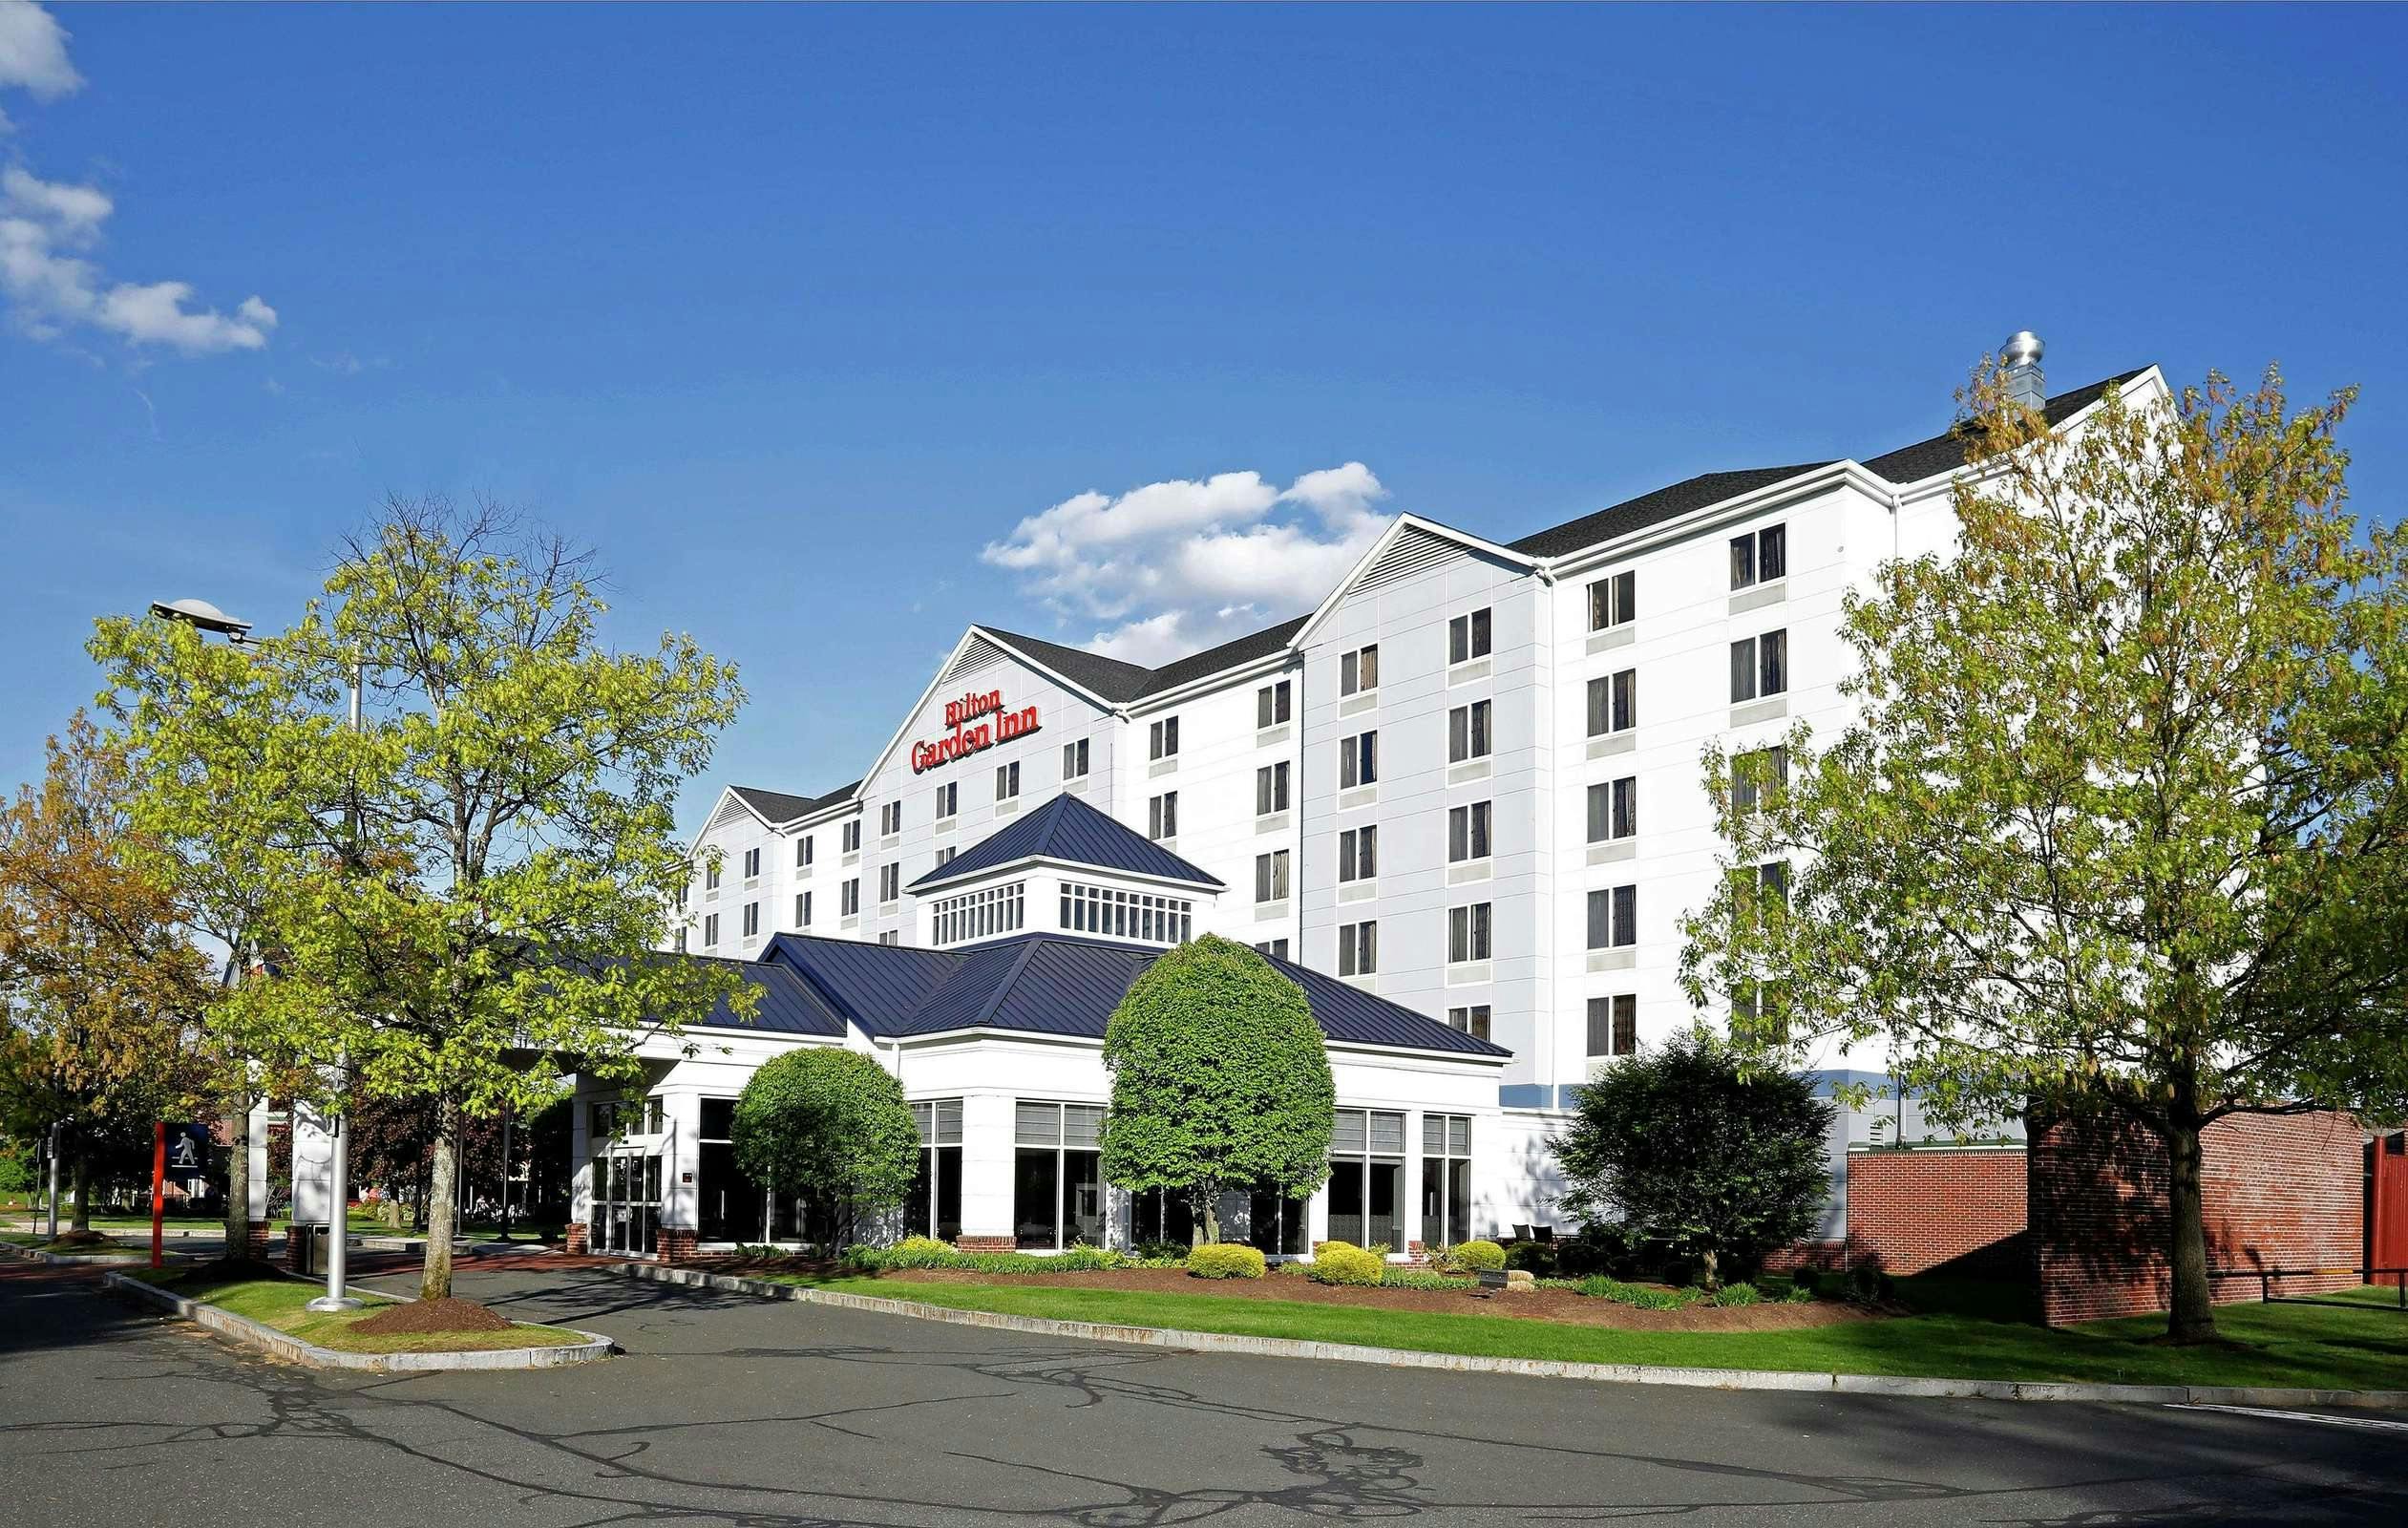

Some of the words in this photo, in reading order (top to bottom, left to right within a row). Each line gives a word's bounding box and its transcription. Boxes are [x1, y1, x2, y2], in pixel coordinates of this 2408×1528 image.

[945, 690, 1002, 727] Hilton
[912, 721, 991, 774] Garden
[995, 705, 1039, 742] Inn
